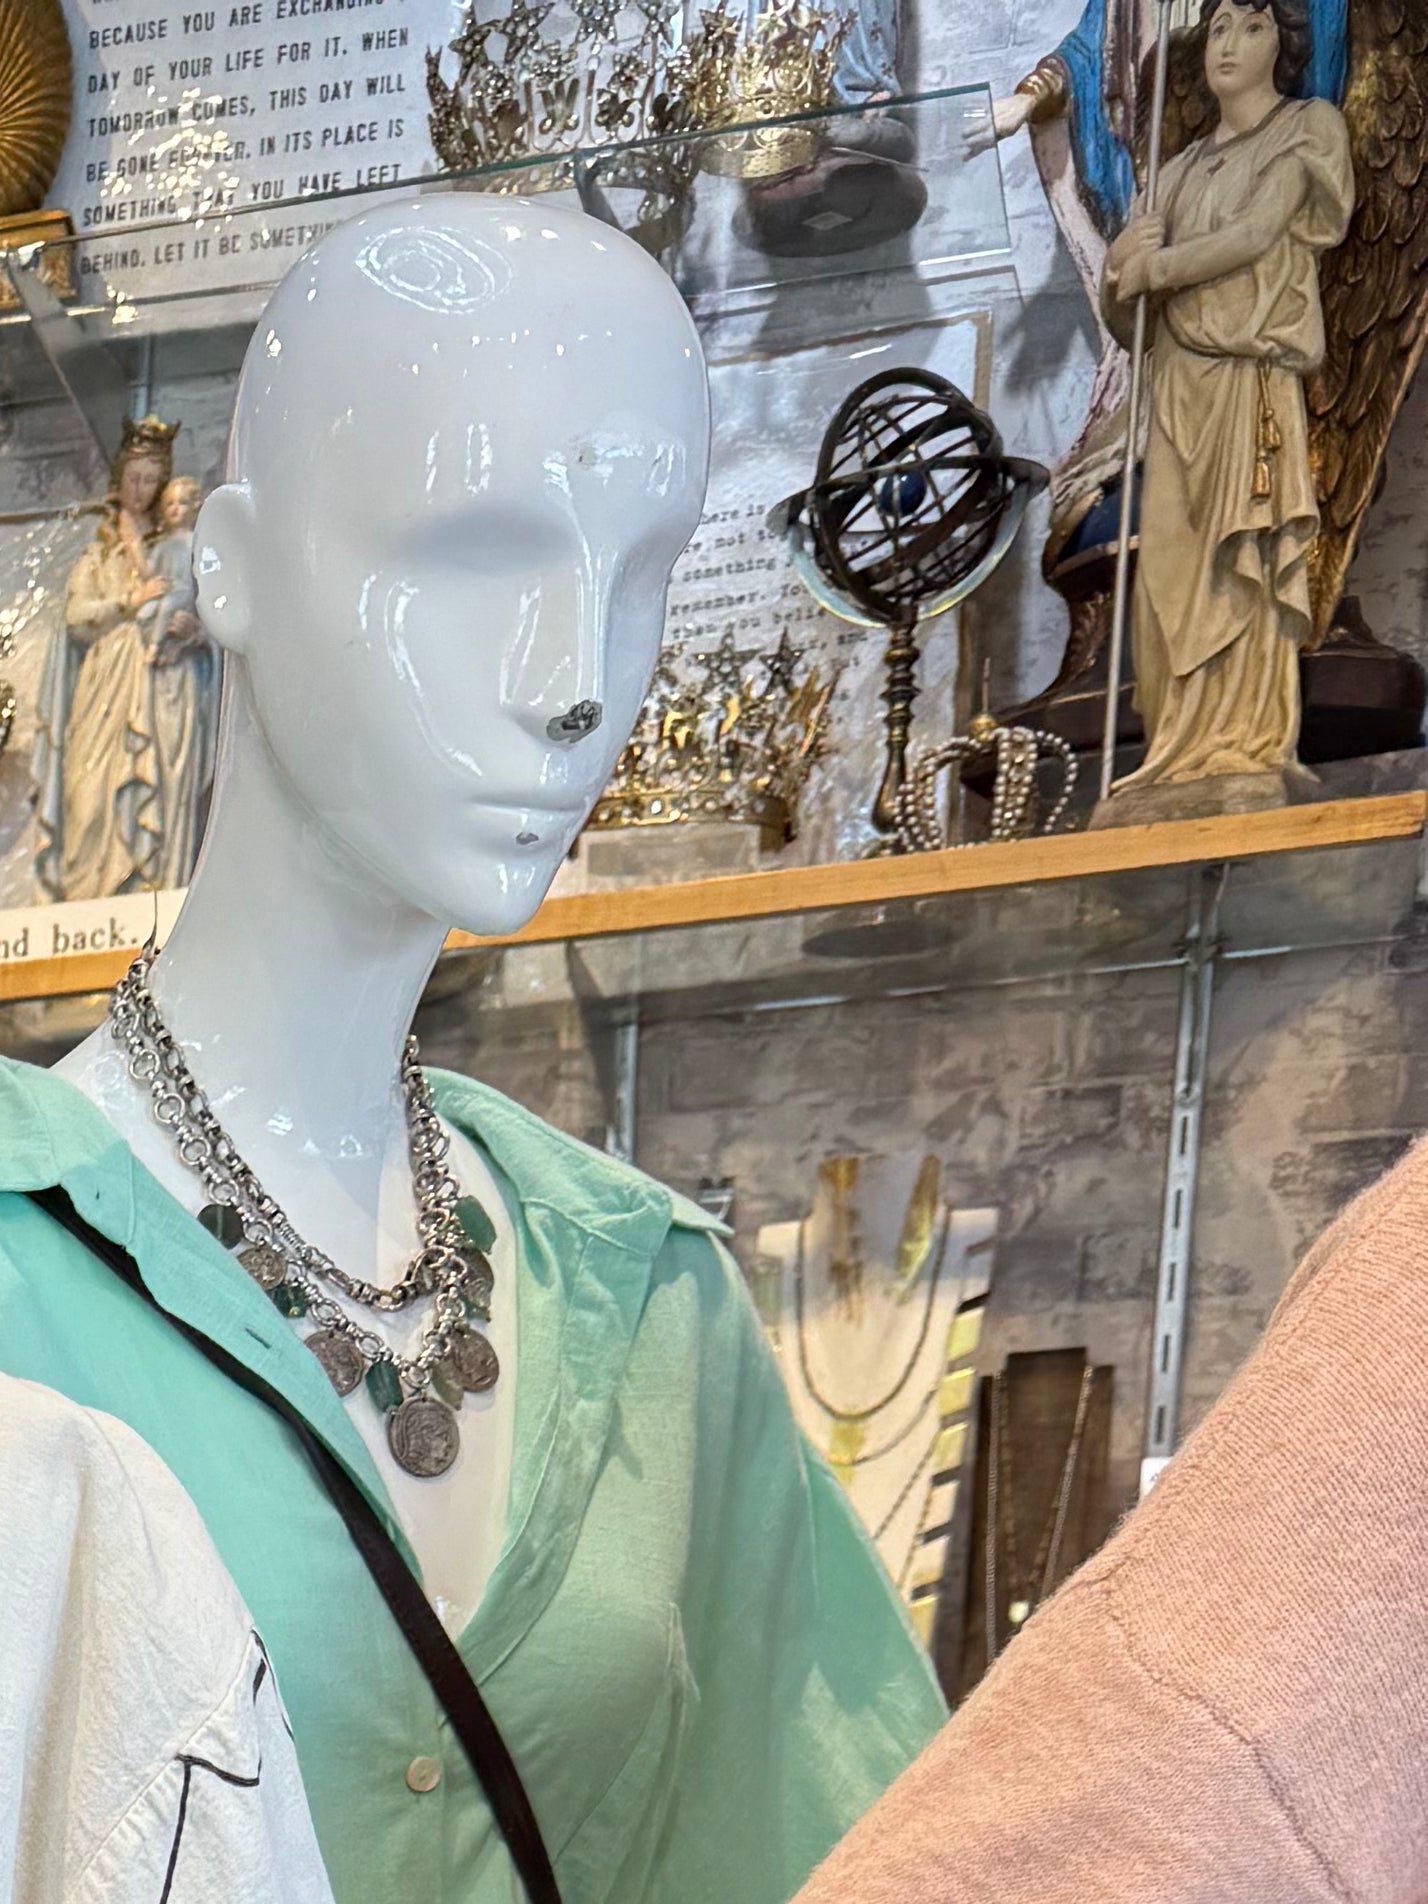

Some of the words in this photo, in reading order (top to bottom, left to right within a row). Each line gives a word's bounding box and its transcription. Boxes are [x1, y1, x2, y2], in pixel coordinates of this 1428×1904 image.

[89, 18, 169, 49] BECAUSE
[183, 11, 215, 35] YOU
[229, 3, 263, 27] ARE
[88, 70, 121, 94] DAY
[134, 65, 155, 86] OF
[169, 56, 213, 81] YOUR
[225, 48, 264, 73] LIFE
[277, 41, 312, 65] FOR
[324, 36, 348, 58] IT.
[362, 27, 409, 52] WHEN
[270, 86, 307, 111] THIS
[319, 80, 353, 104] DAY
[366, 73, 406, 97] WILL
[260, 135, 276, 157] IN
[285, 130, 313, 153] ITS
[322, 121, 378, 148] PLACE
[387, 118, 404, 139] IS
[251, 179, 285, 202] YOU
[298, 171, 342, 194] HAVE
[356, 163, 402, 189] LEFT
[154, 241, 186, 265] LET
[194, 237, 211, 259] IT
[51, 917, 139, 956] back.
